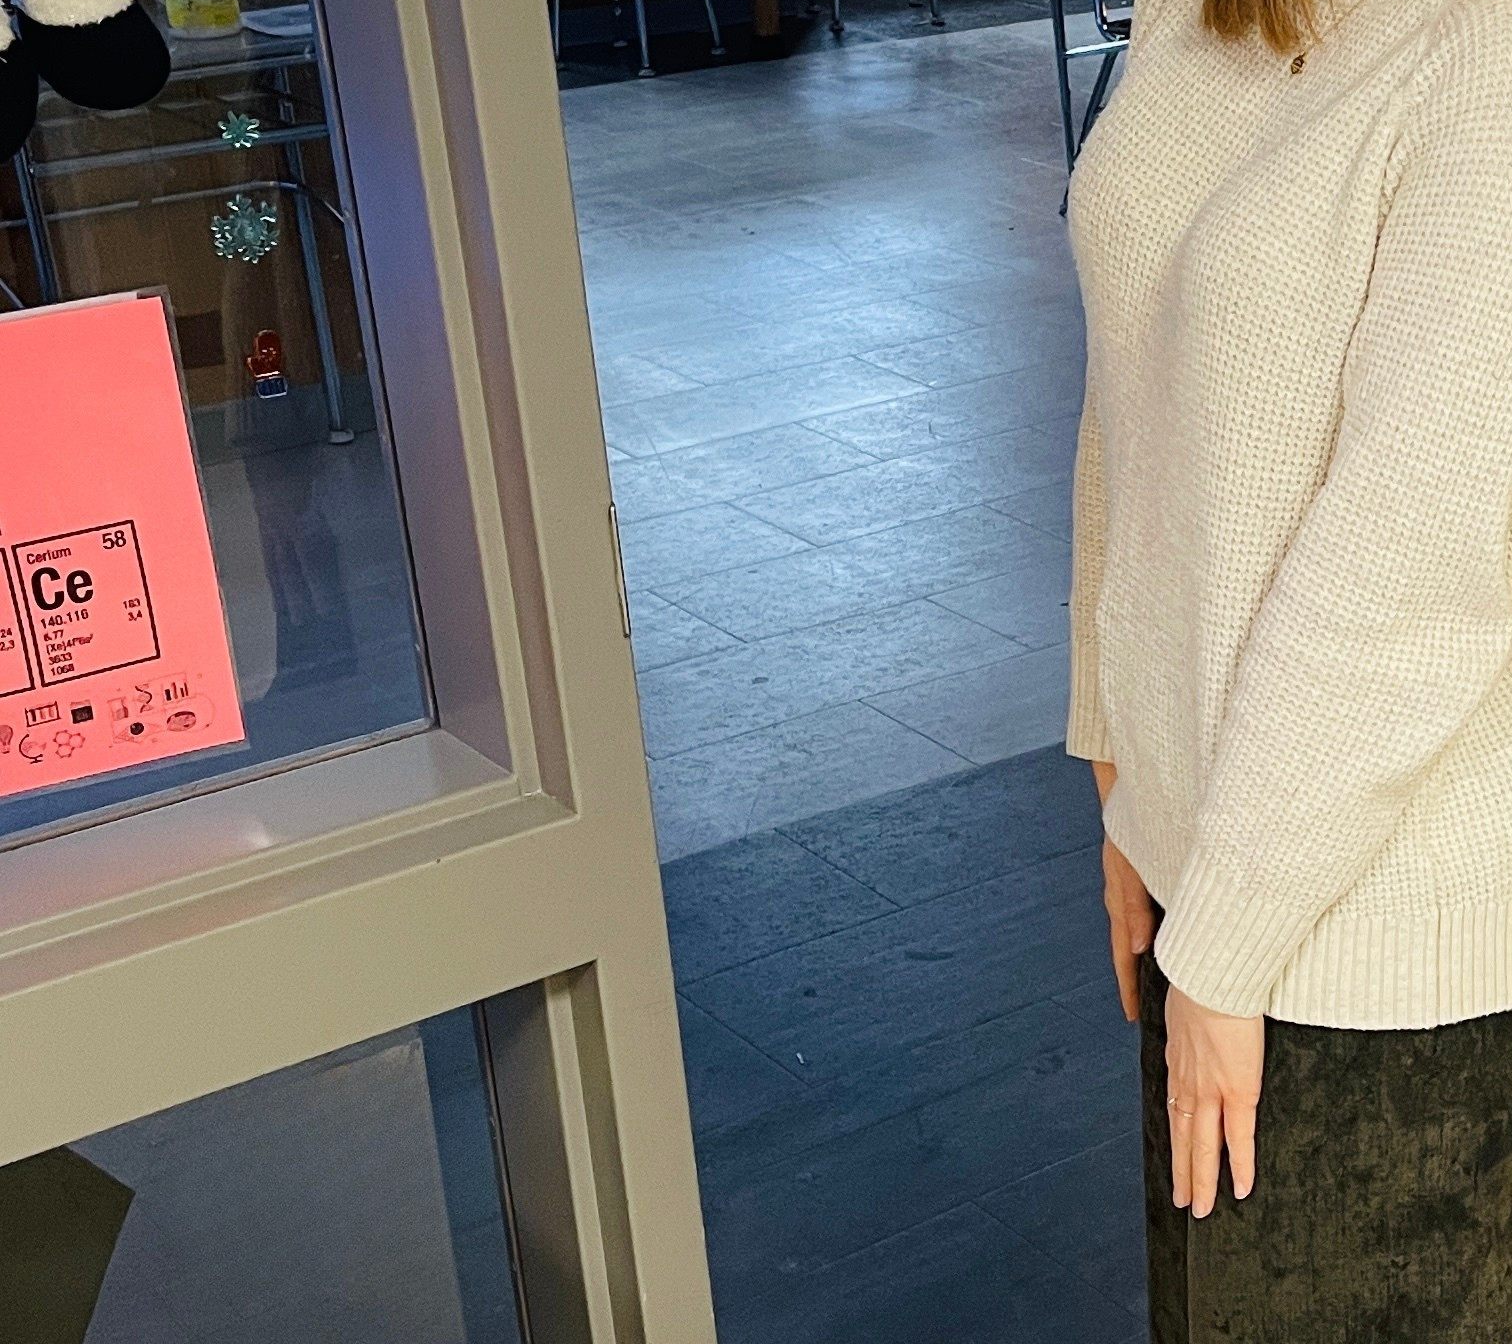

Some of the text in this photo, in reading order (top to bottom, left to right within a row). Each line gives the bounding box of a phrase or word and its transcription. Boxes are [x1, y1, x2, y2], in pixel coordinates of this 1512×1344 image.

[102, 530, 127, 550] 58
[26, 547, 72, 565] Cerium
[31, 567, 94, 611] Ce
[40, 608, 89, 629] 140.116
